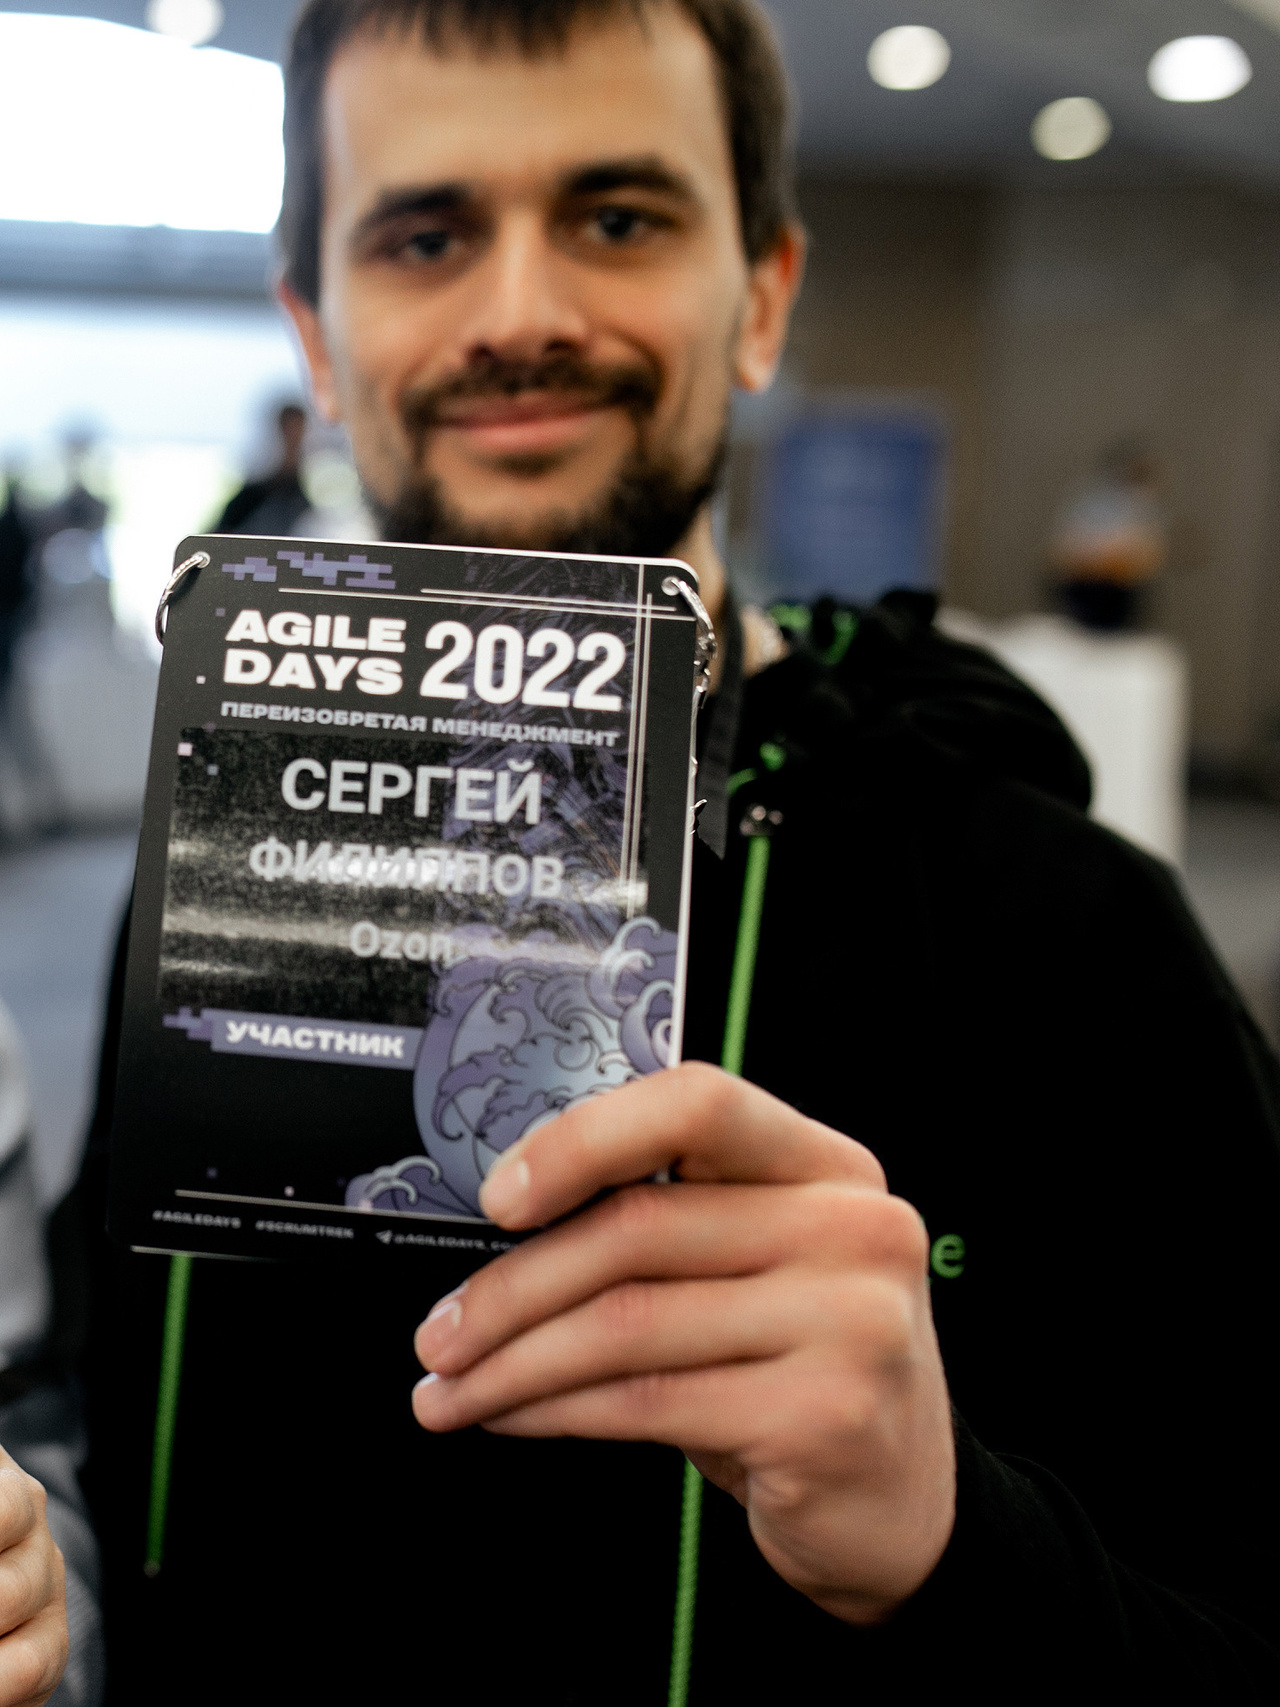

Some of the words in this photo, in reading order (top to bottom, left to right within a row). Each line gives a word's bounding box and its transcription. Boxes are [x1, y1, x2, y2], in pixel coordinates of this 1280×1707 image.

[225, 609, 407, 653] AGILE
[224, 648, 404, 696] DAYS
[420, 620, 626, 712] 2022
[221, 701, 426, 732] ПЕРЕИЗОБРЕТАЯ
[432, 717, 620, 748] МЕНЕДЖМЕНТ
[281, 757, 542, 825] СЕРГЕЙ
[349, 920, 452, 961] Ozon
[225, 1020, 406, 1059] УЧАСТНИК
